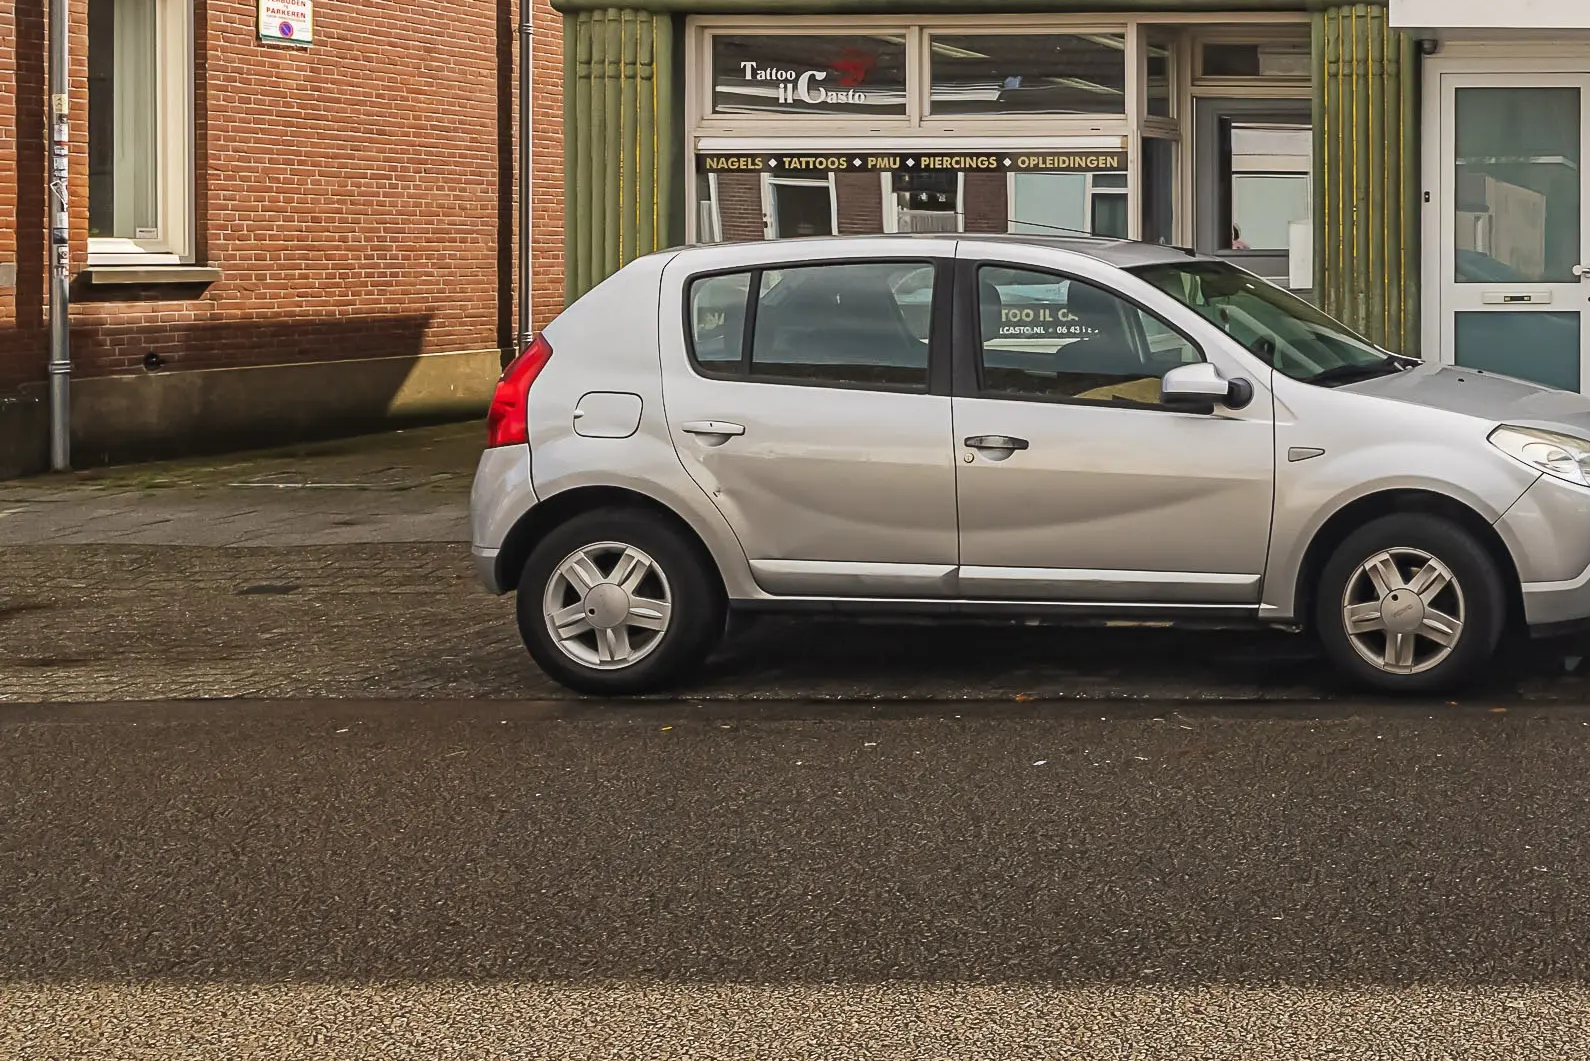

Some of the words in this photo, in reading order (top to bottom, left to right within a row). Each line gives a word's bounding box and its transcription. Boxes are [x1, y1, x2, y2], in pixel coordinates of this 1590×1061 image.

[266, 7, 306, 19] PARKEREN
[740, 61, 796, 80] Tattoo
[778, 83, 794, 103] il
[797, 70, 866, 104] Casto
[705, 157, 763, 169] NAGELS
[782, 157, 848, 169] TATTOOS
[867, 157, 900, 169] PMU
[920, 156, 998, 169] PIERCINGS
[1017, 156, 1119, 169] OPLEIDINGEN
[1001, 308, 1034, 322] TOO
[1040, 308, 1053, 321] IL
[1057, 308, 1079, 321] CA
[999, 326, 1046, 334] LCASTO.NL
